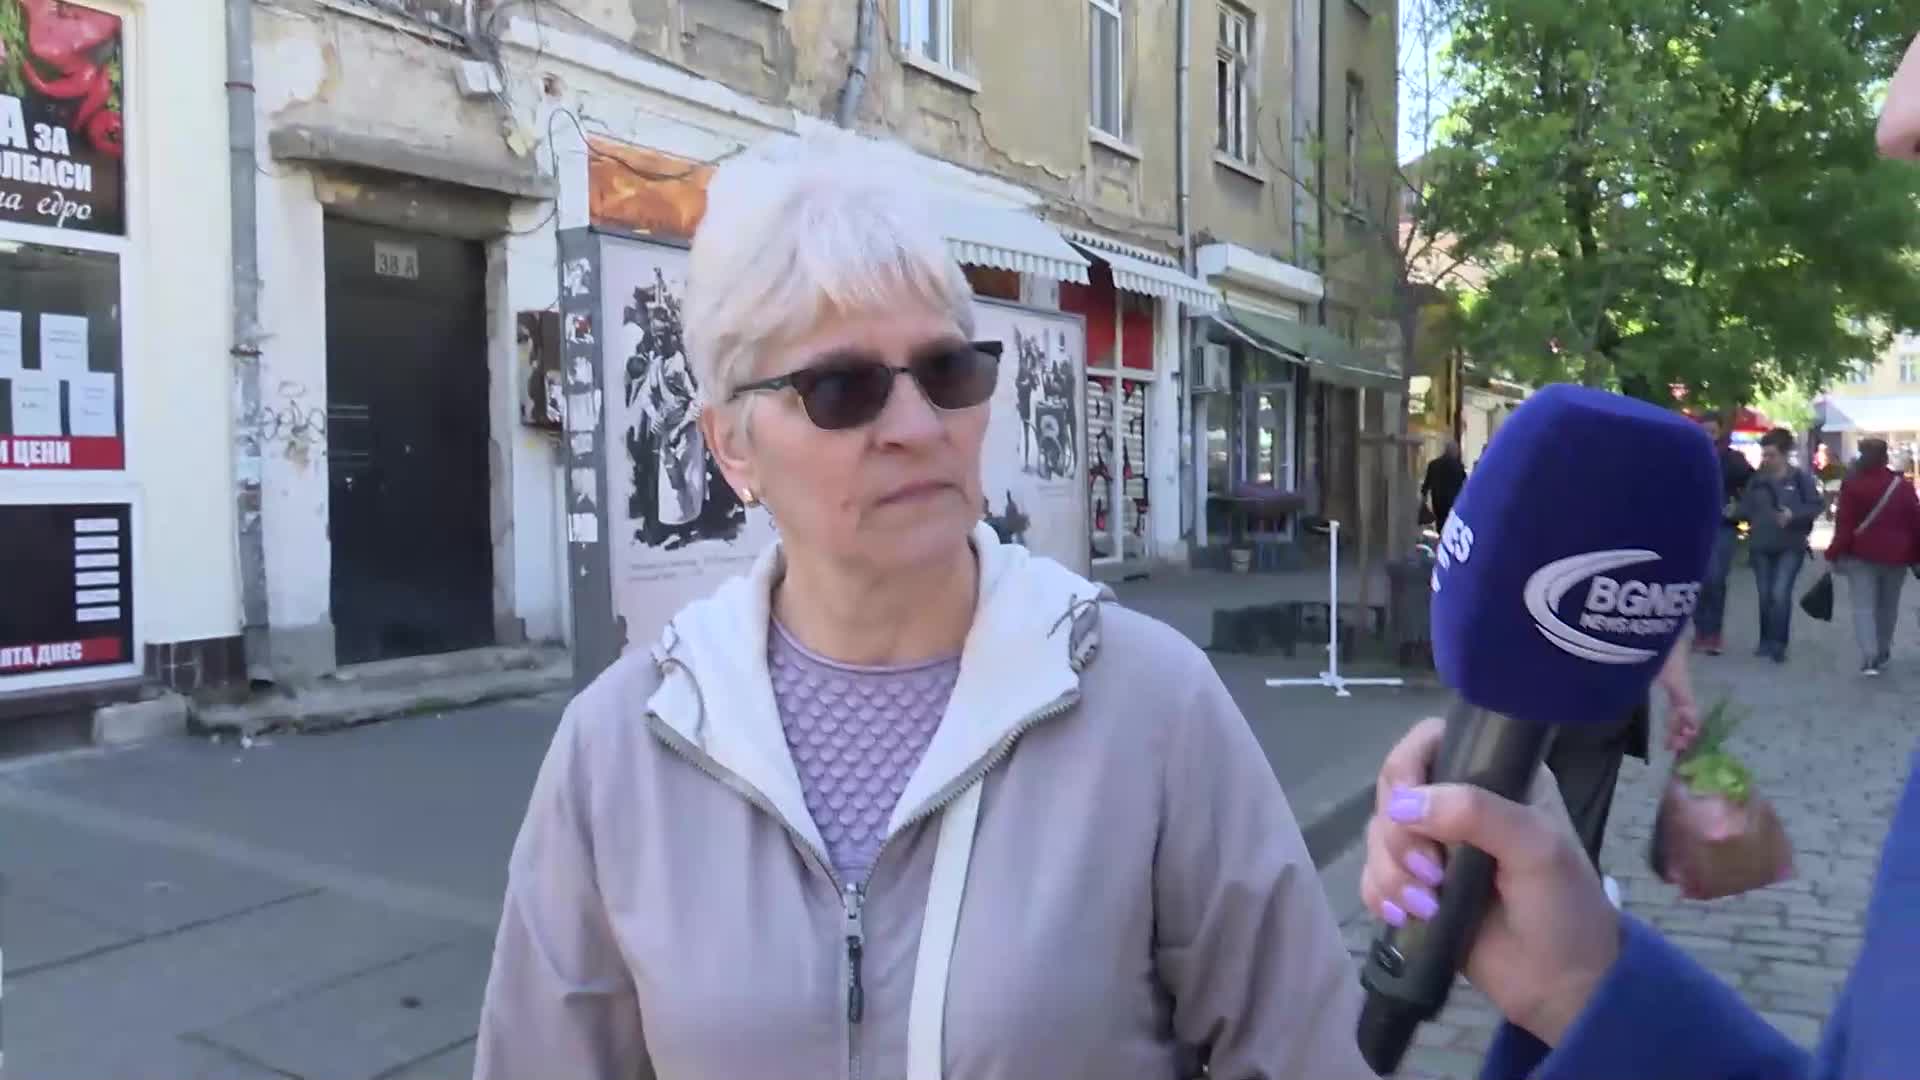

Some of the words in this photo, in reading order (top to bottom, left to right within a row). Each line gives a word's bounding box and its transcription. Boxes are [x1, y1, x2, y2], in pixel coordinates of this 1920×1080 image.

[33, 122, 71, 156] ЗА
[0, 150, 92, 192] ЛБАСИ
[37, 190, 92, 228] едро
[13, 439, 71, 468] ЦЕНИ
[1584, 575, 1700, 617] BGNES
